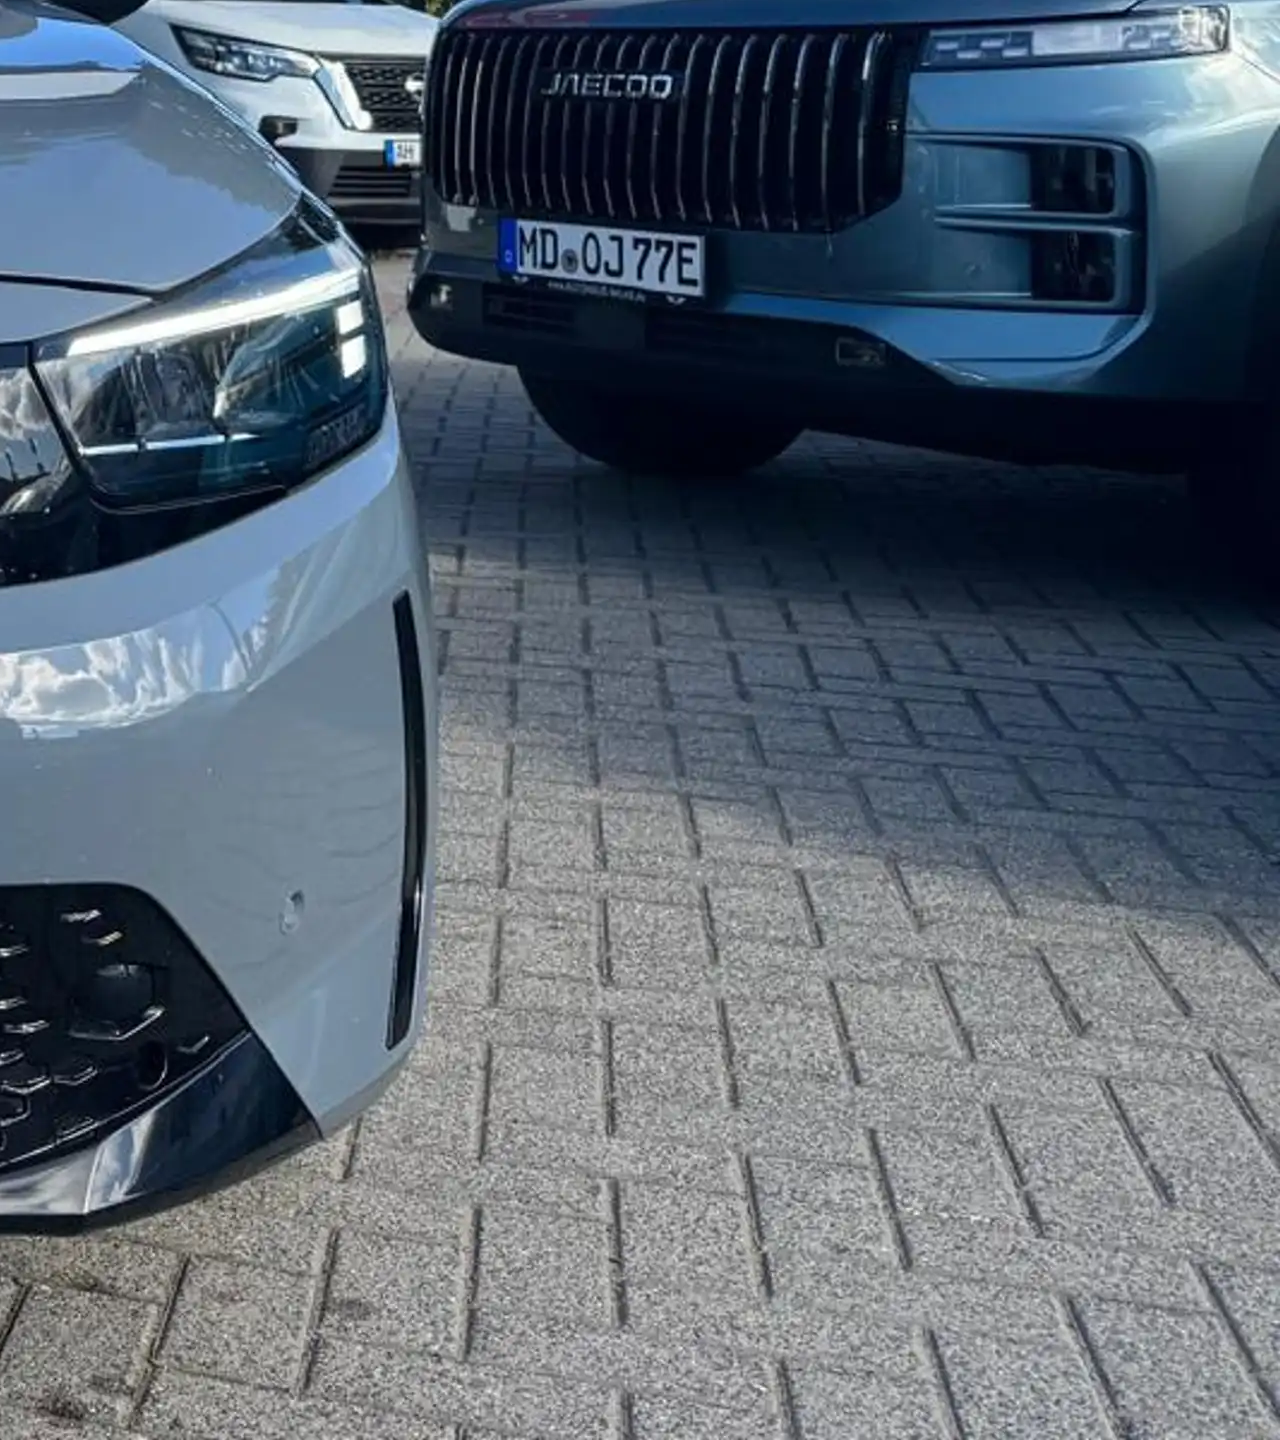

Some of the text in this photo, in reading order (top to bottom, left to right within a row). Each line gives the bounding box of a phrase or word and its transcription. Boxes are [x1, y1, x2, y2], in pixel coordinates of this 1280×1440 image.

[540, 71, 674, 100] JAECOO
[518, 224, 699, 288] MD OJ 77E
